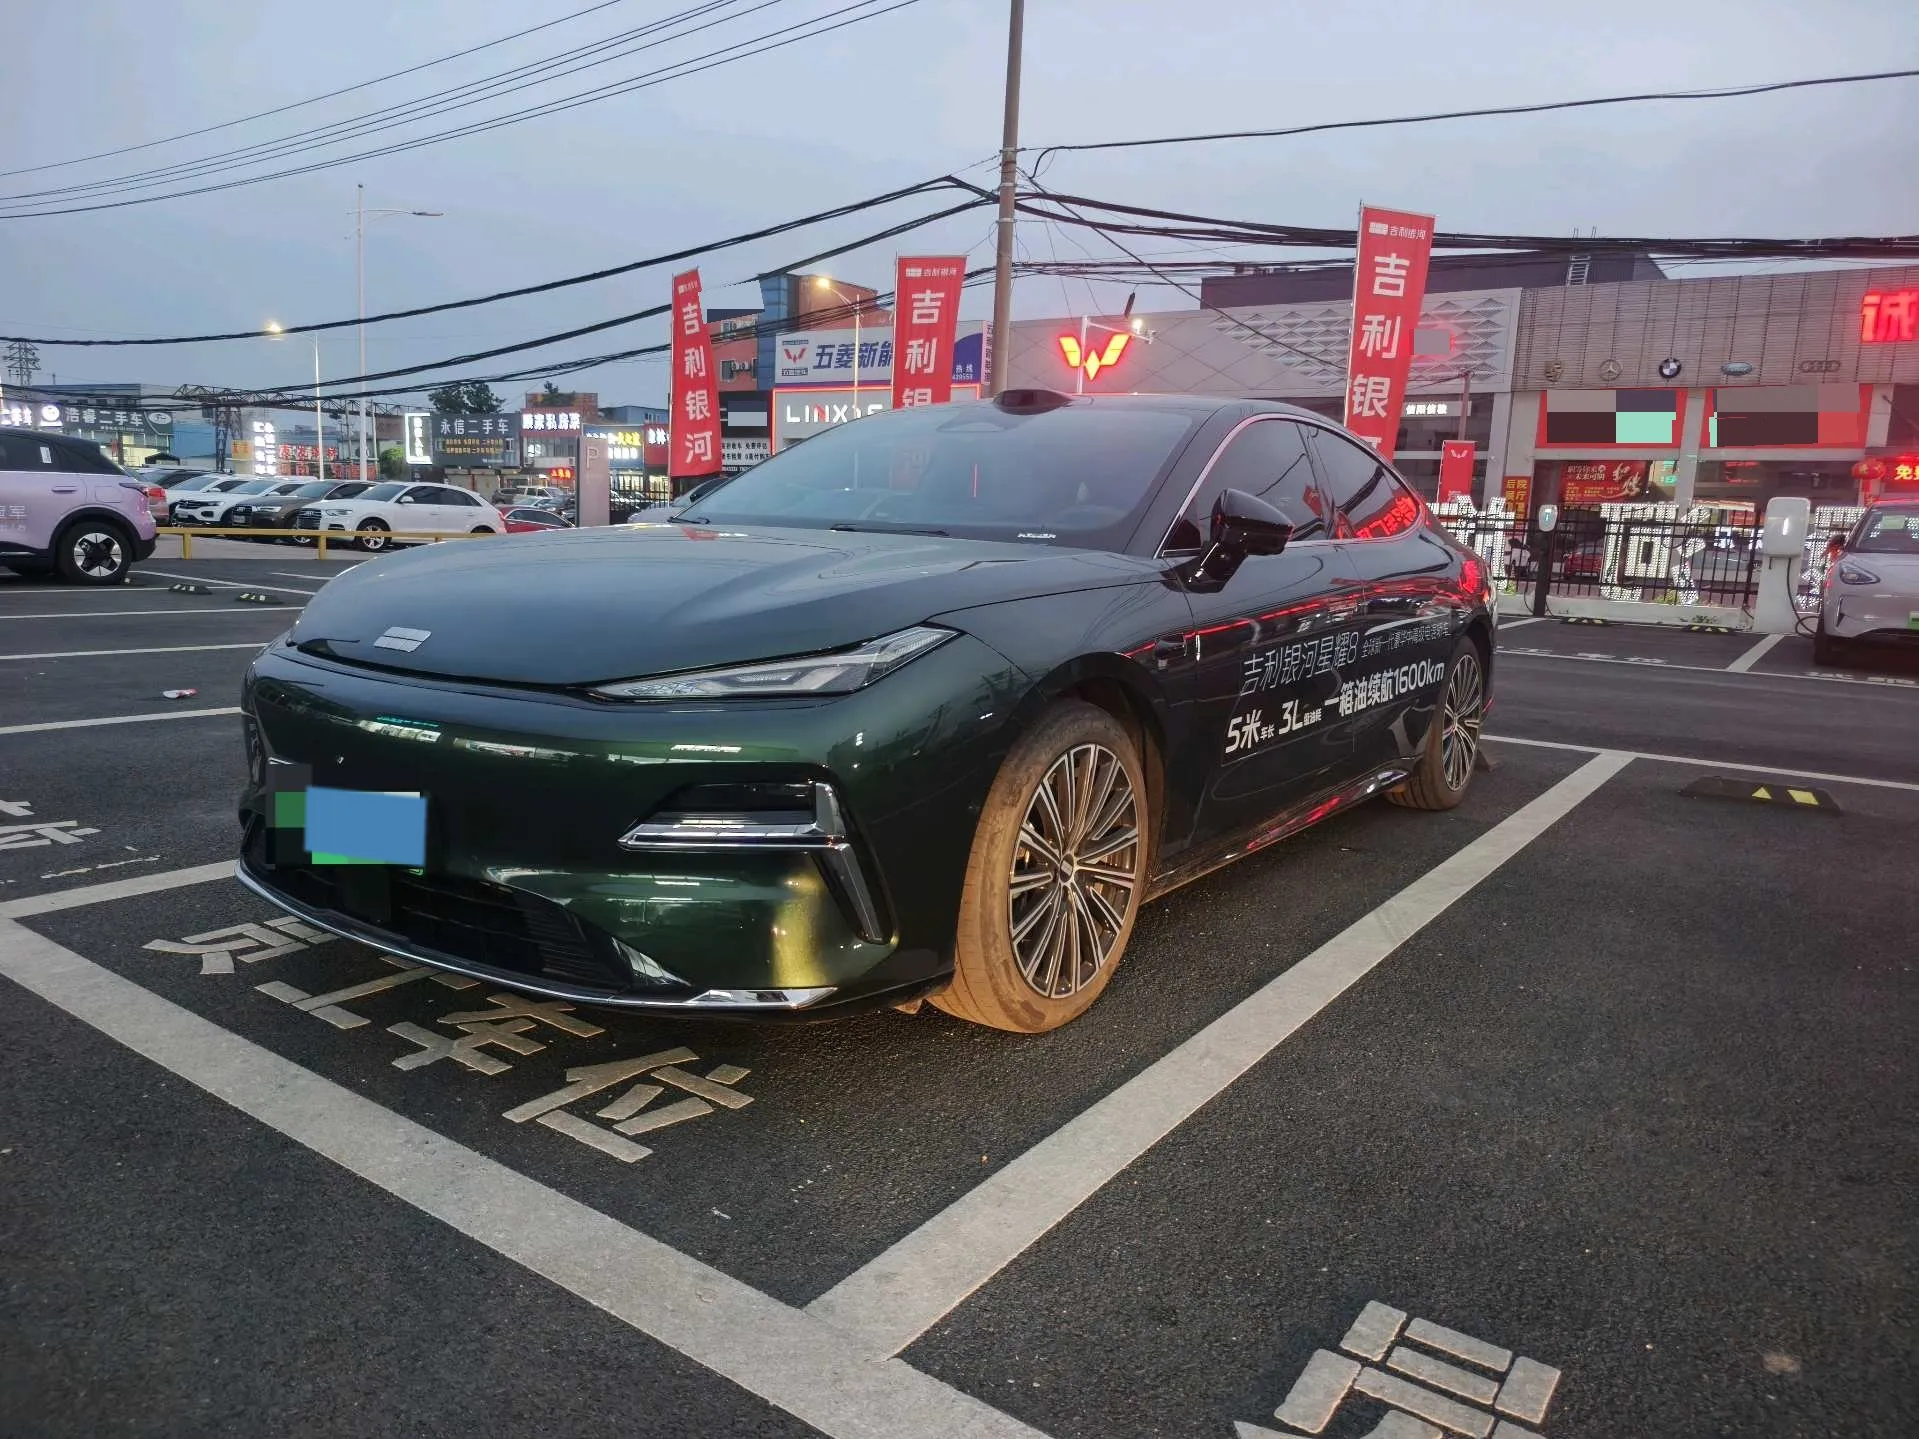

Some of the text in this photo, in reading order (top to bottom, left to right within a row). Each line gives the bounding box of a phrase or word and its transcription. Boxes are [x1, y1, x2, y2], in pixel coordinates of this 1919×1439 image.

[682, 302, 714, 463] 吉利银河
[440, 418, 509, 435] 永信二手车
[1240, 631, 1359, 697] 吉利银河星耀8
